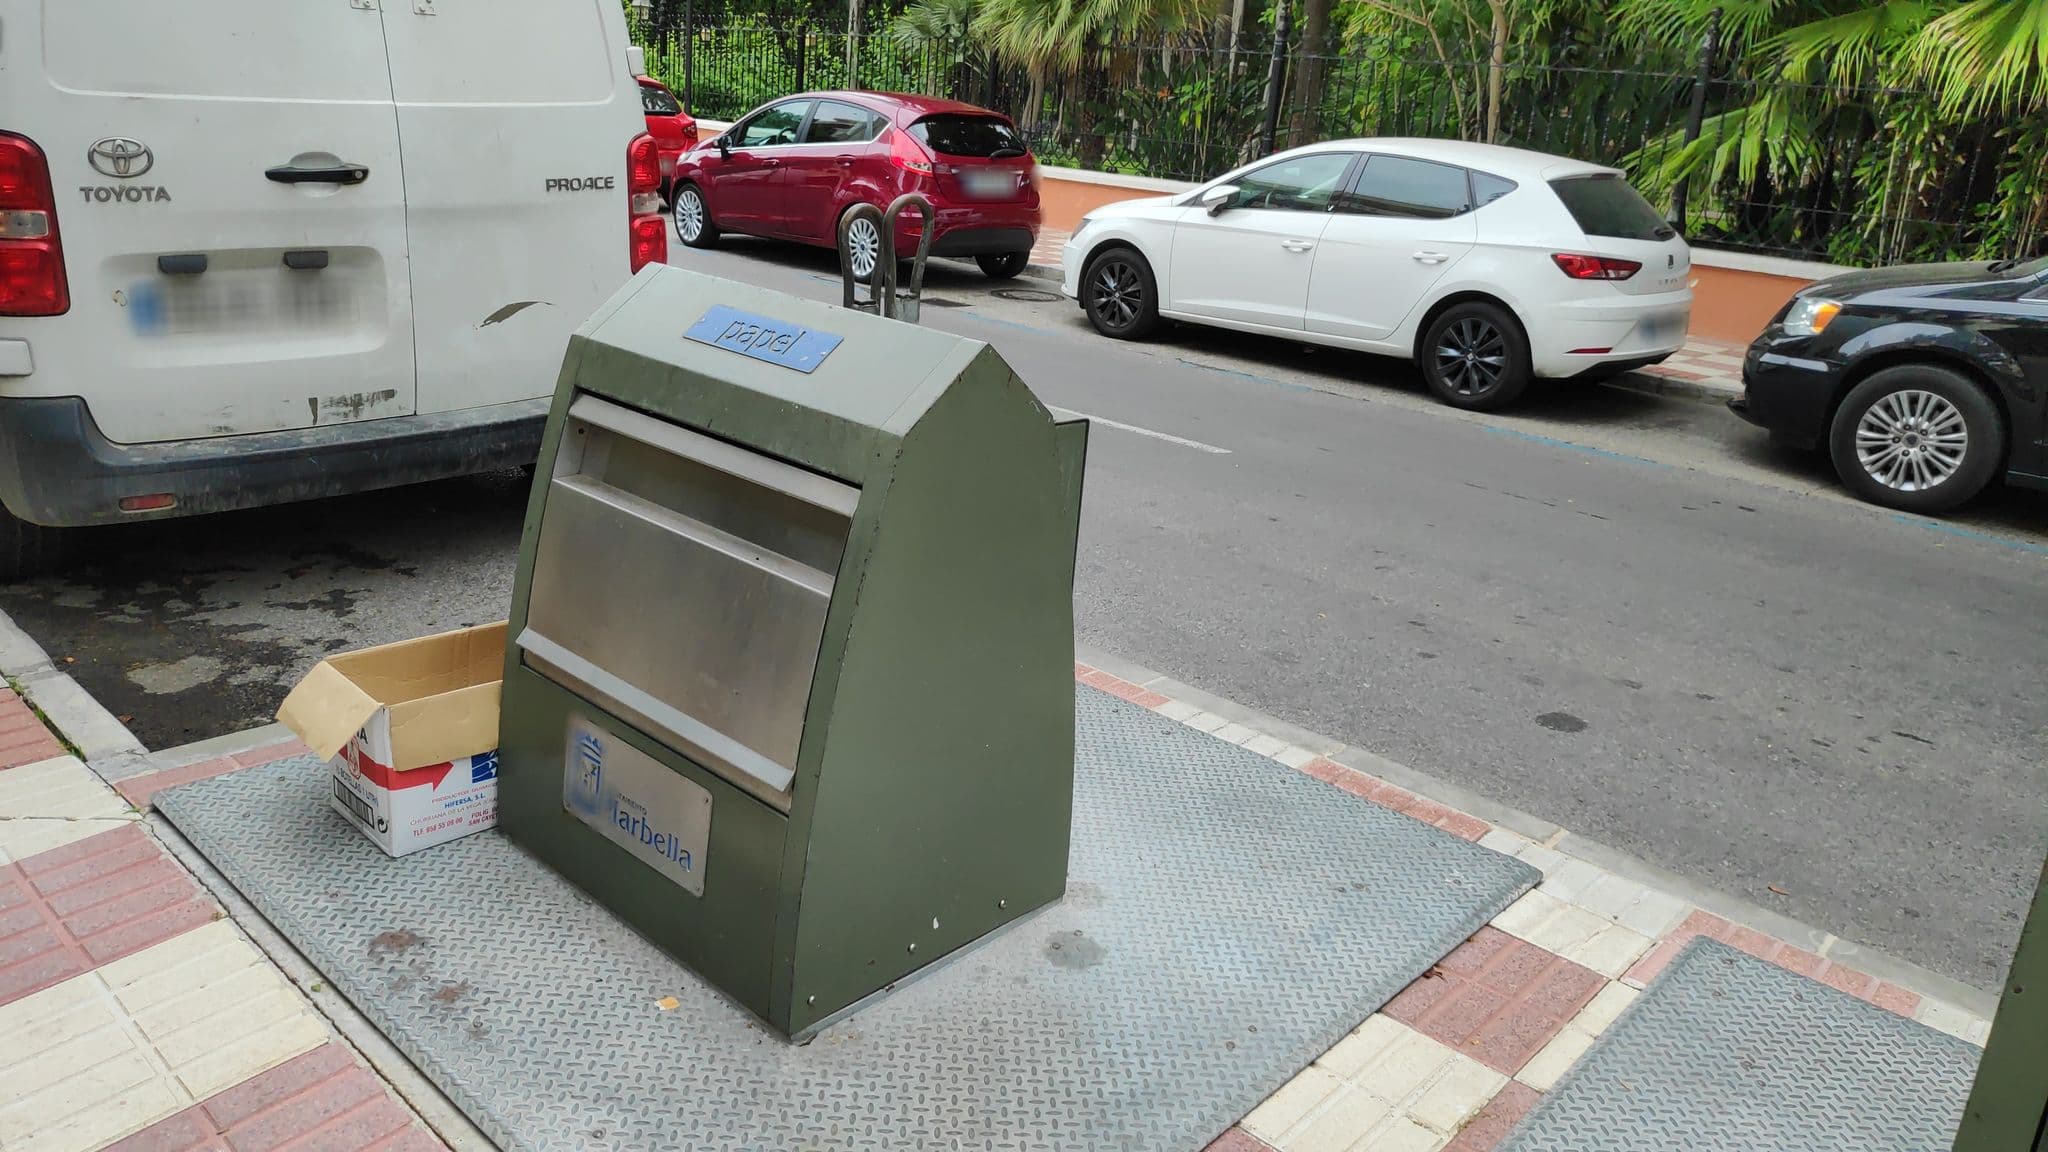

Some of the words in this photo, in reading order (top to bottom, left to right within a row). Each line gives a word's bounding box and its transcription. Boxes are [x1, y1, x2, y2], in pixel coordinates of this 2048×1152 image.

[545, 176, 615, 192] PROACE
[79, 185, 171, 203] TOYOTA
[714, 320, 807, 355] papel
[481, 812, 498, 824] CAYET
